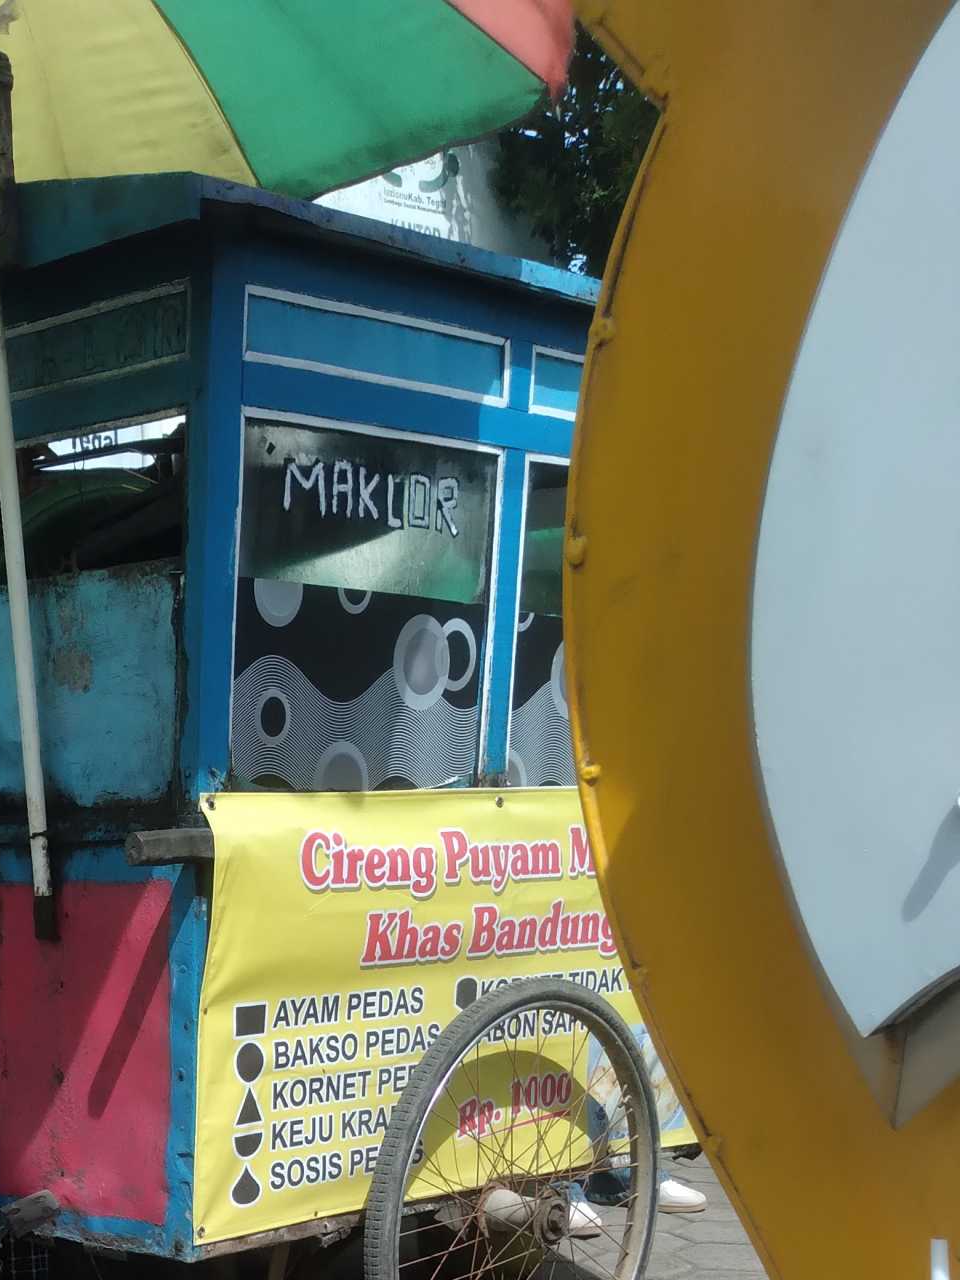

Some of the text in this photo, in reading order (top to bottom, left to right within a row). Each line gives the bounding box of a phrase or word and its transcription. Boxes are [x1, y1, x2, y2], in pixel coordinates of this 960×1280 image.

[300, 831, 436, 895] Cireng
[441, 830, 561, 890] Puyam
[362, 900, 617, 963] Khas Bandung
[273, 987, 424, 1028] AYAM PEDAS
[274, 1023, 440, 1069] BAKSO PEDAS
[272, 1070, 371, 1110] KORNET
[458, 1072, 572, 1138] Rp. 1000
[271, 1115, 333, 1151] KEJU
[270, 1152, 342, 1190] SOSIS
